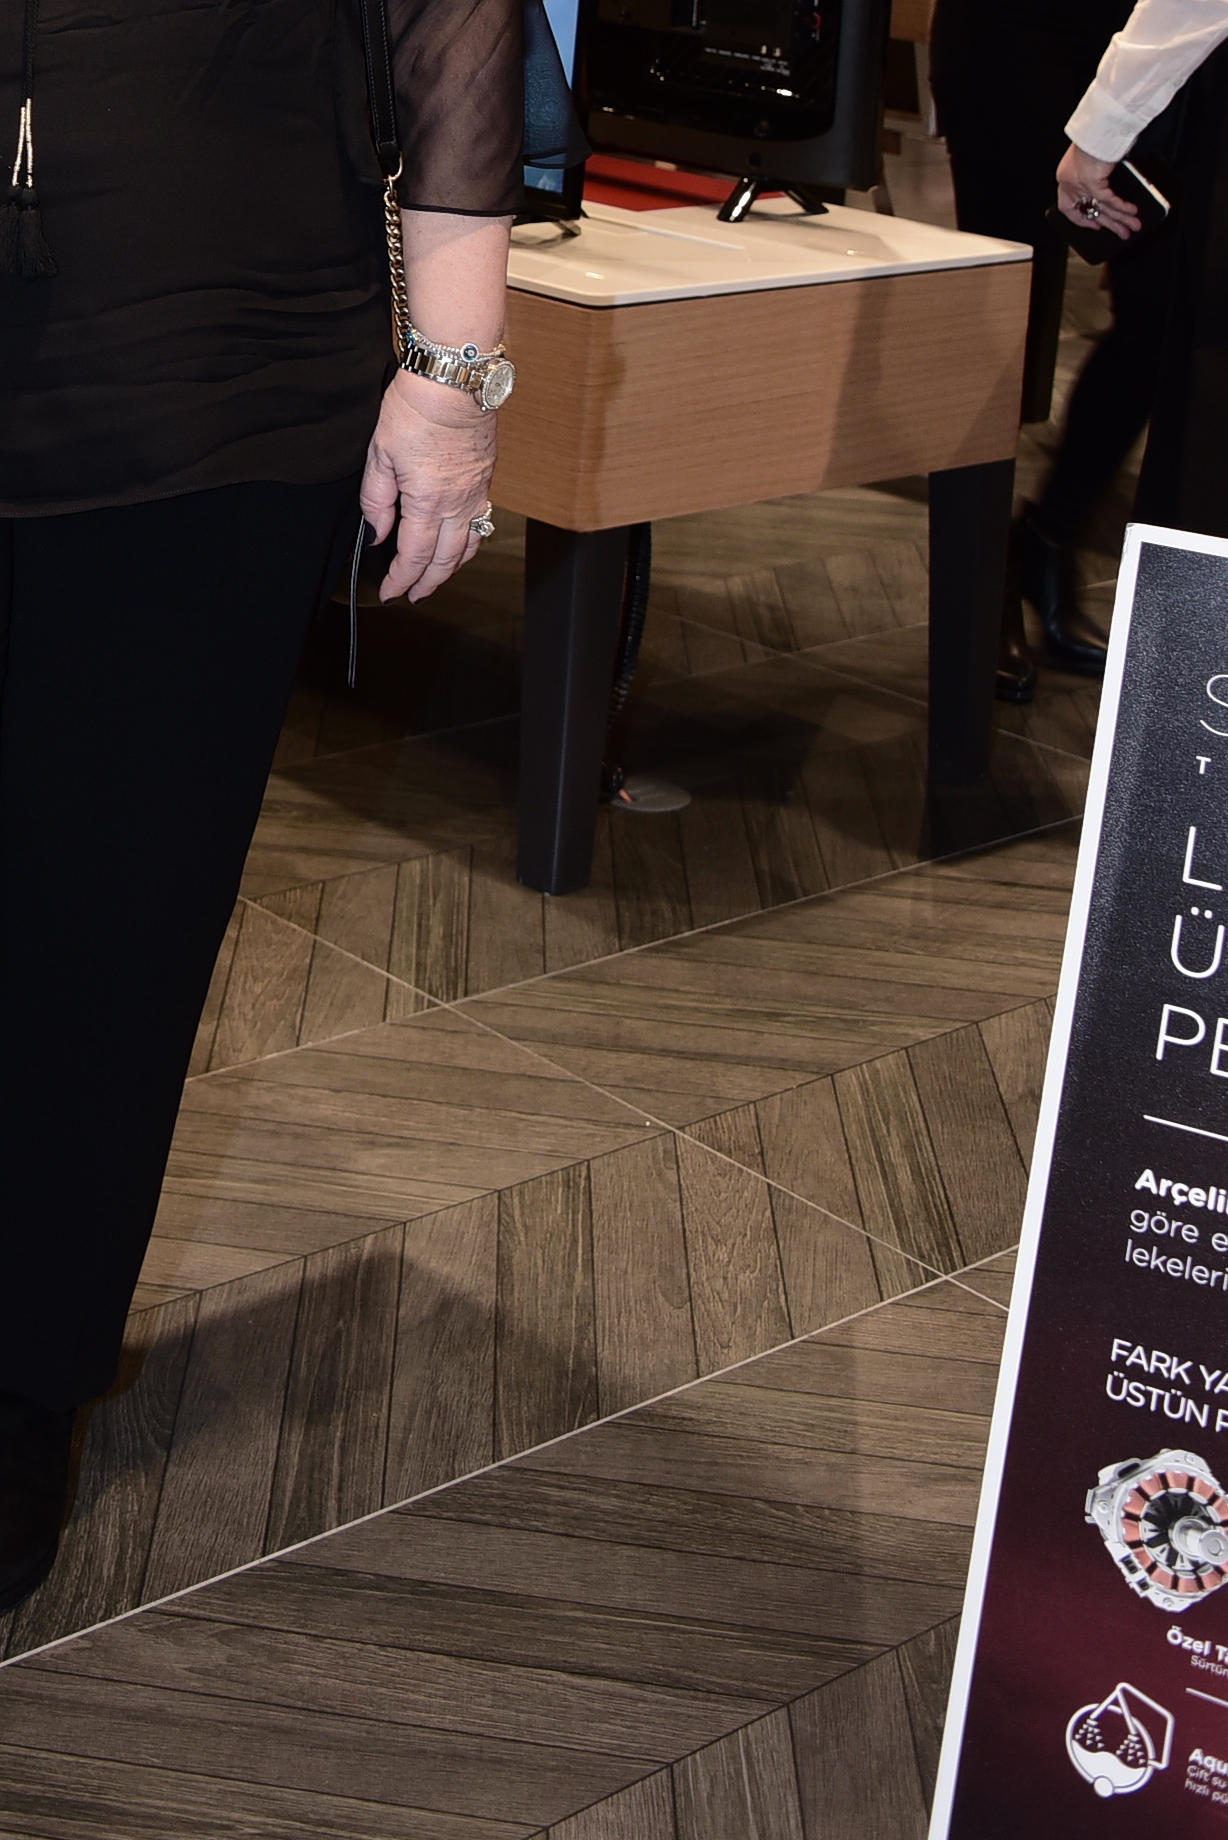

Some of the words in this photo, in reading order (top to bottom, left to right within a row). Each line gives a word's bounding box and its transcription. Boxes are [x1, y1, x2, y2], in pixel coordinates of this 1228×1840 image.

[1171, 906, 1225, 979] Ü
[1134, 1168, 1228, 1215] Arçeli
[1130, 1210, 1200, 1244] göre
[1111, 1338, 1193, 1386] FARK
[1106, 1371, 1210, 1429] ÜSTÜN
[1166, 1625, 1212, 1657] Özel
